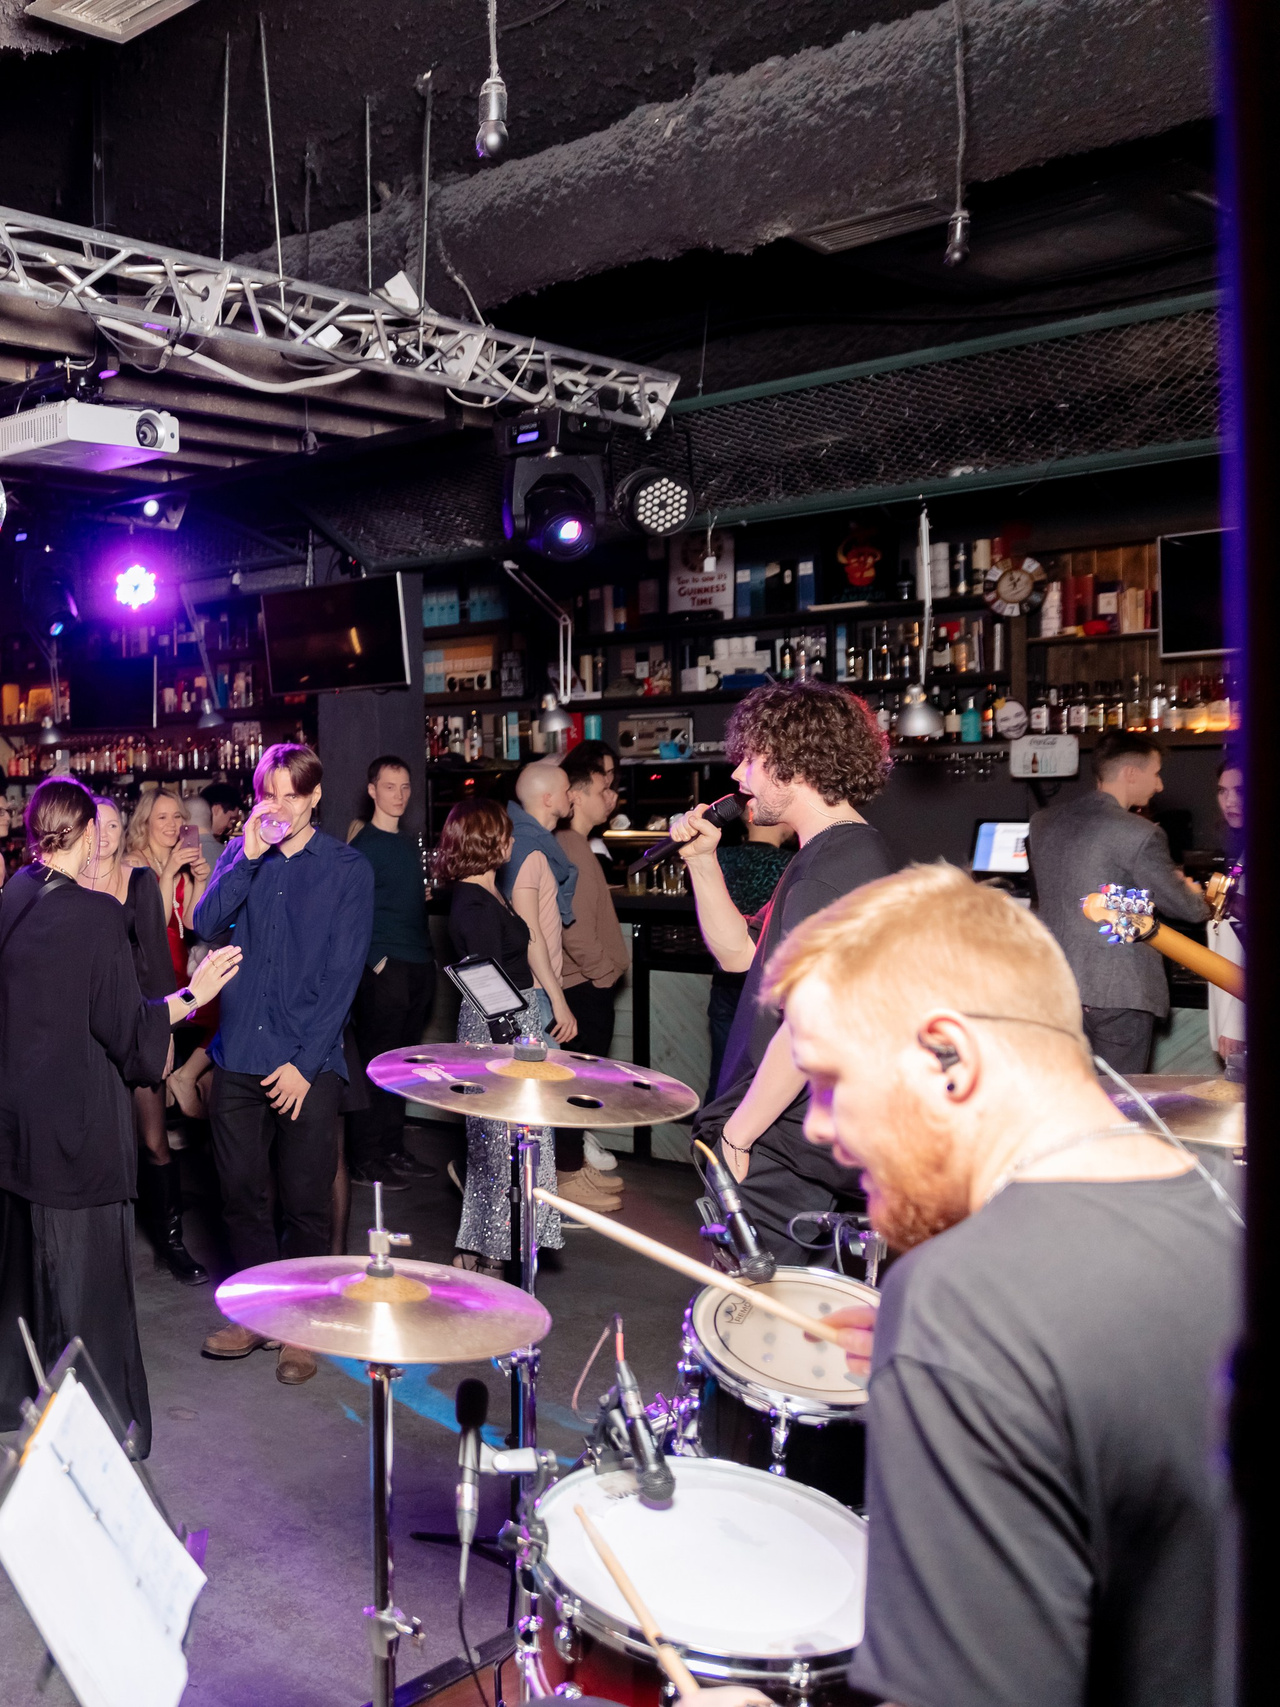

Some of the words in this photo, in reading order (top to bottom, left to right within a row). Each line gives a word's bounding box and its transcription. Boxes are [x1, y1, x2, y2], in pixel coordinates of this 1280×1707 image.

[678, 583, 726, 597] GUINNESS
[691, 596, 713, 606] TIME
[734, 1301, 751, 1322] REMO
